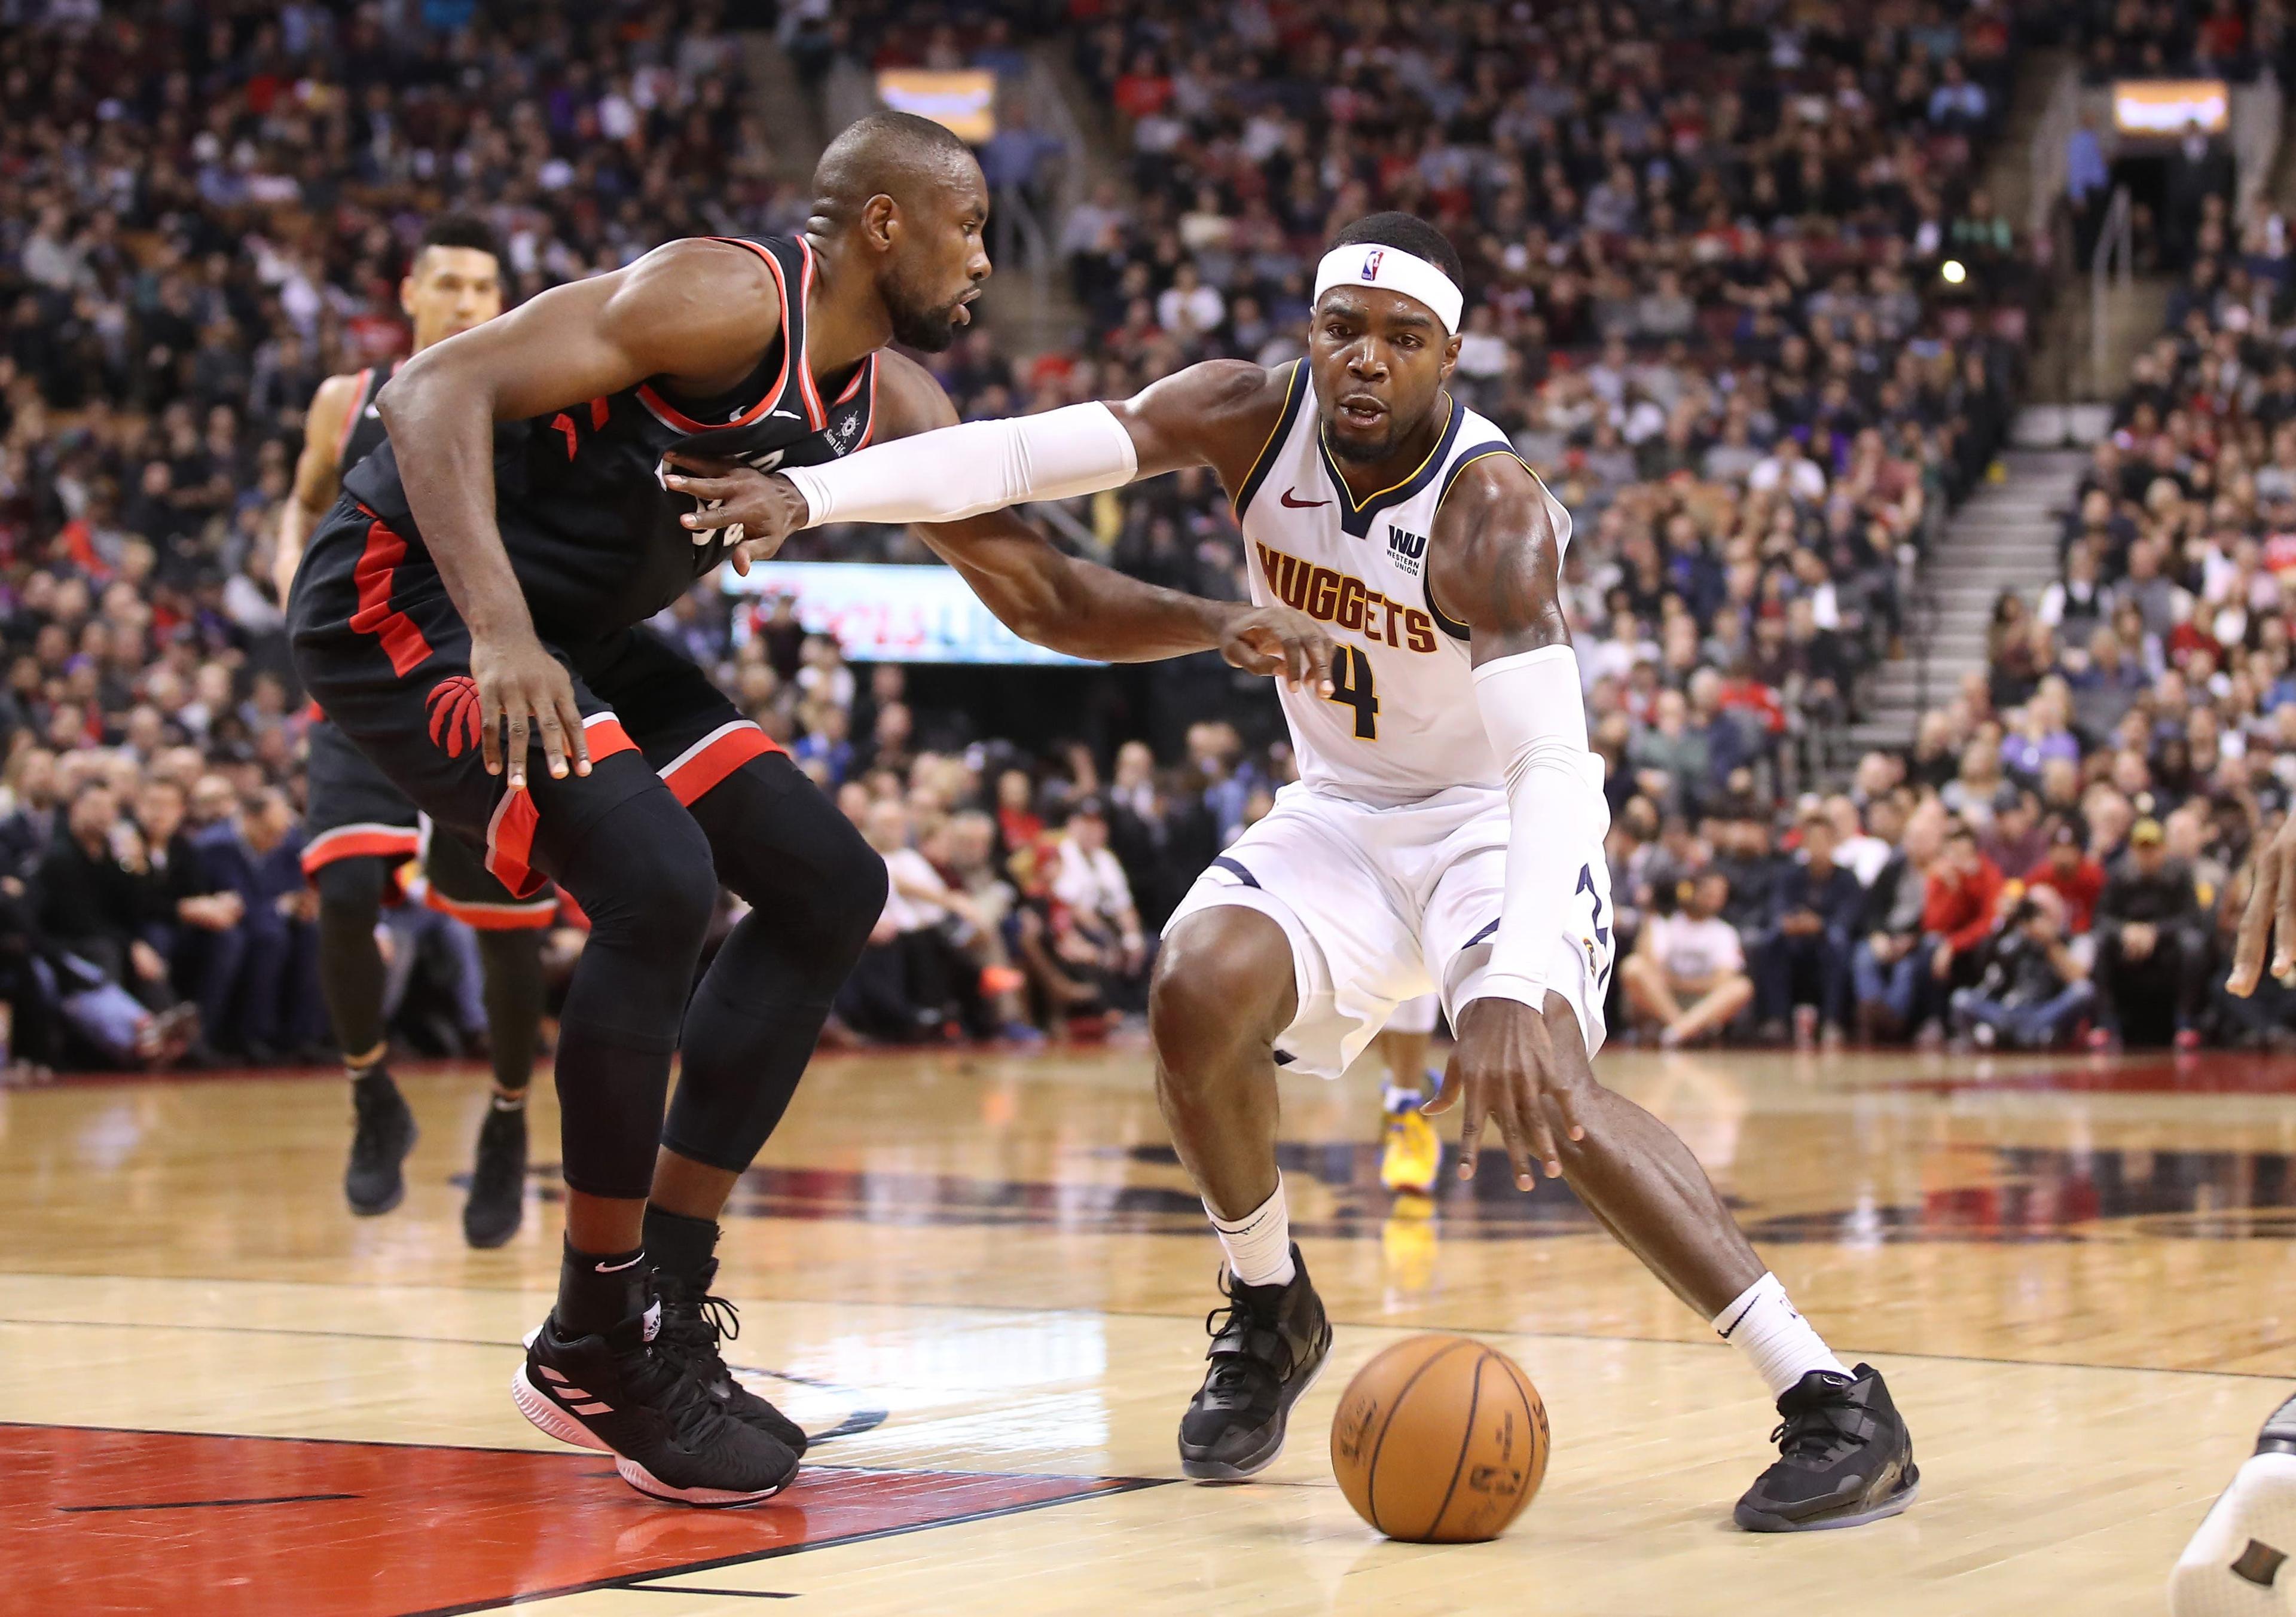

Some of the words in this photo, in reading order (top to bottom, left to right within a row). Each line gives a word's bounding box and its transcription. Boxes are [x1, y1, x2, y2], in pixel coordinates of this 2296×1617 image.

[824, 429, 836, 446] Sun
[1388, 524, 1427, 559] WU
[1387, 549, 1419, 569] WESTERN
[1394, 561, 1418, 576] UNION
[1256, 540, 1440, 655] NUGGETS
[1325, 643, 1382, 742] 4
